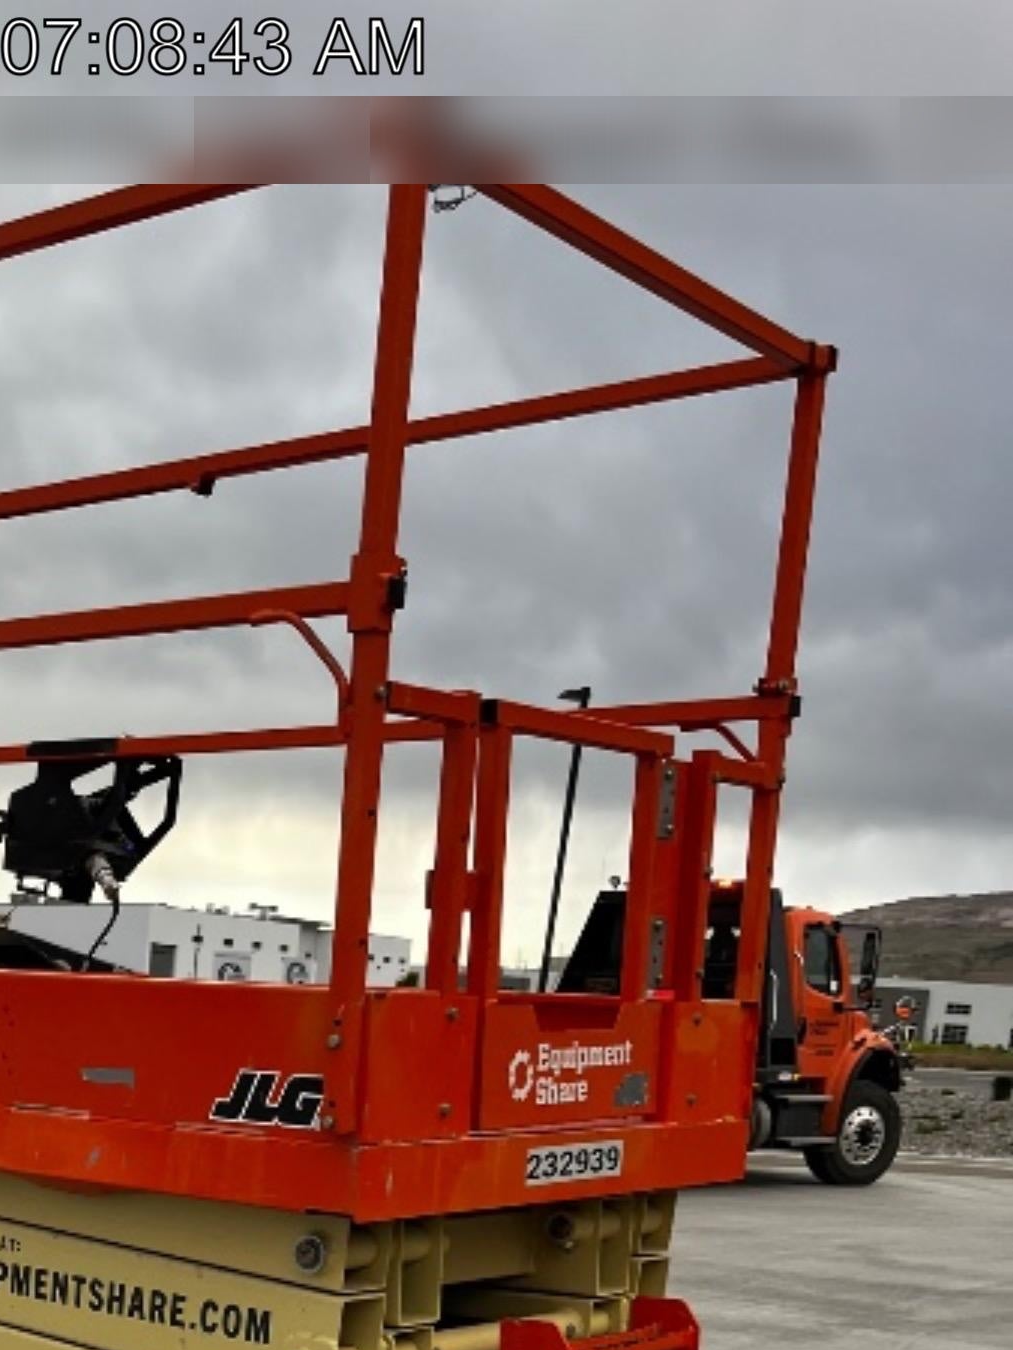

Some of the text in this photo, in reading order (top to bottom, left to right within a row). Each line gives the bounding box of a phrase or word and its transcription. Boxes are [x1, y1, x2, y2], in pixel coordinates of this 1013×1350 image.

[537, 1040, 633, 1075] Equipment
[209, 1068, 325, 1130] JLG
[535, 1077, 588, 1105] Share
[526, 1146, 619, 1181] 232939
